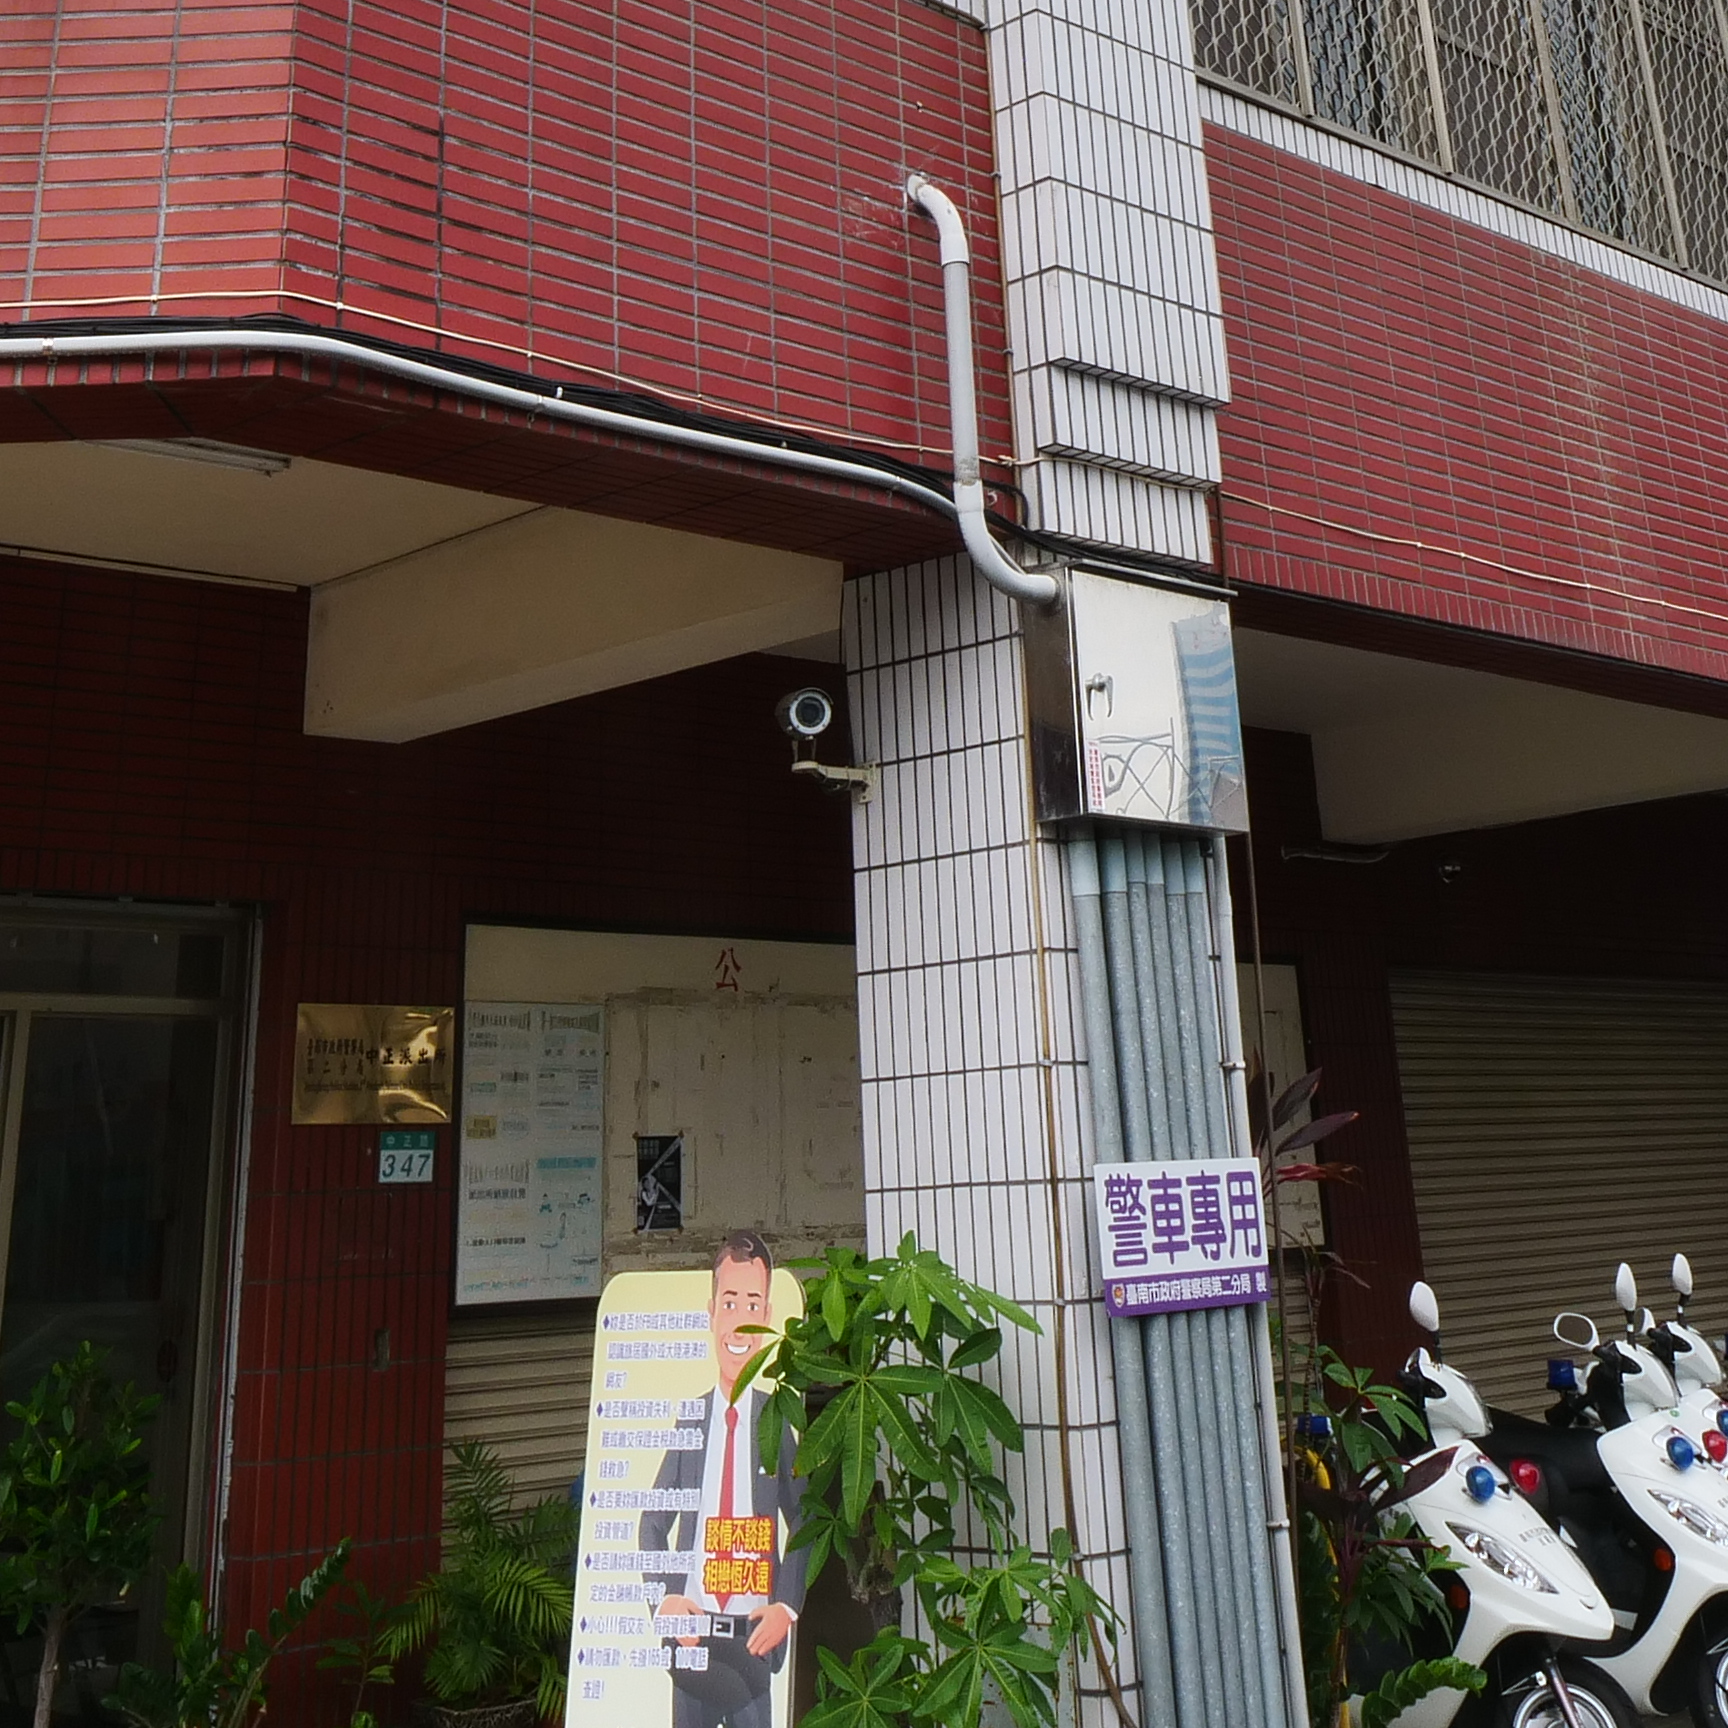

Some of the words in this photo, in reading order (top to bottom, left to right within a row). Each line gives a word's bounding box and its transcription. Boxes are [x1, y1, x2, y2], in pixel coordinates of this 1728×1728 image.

[714, 946, 741, 993] 公
[365, 1044, 447, 1065] 中正派出所
[382, 1154, 430, 1178] 347
[1104, 1169, 1262, 1268] 警車專用
[706, 1518, 772, 1552] 談情不談錢
[703, 1559, 770, 1594] 相戀恆久遠
